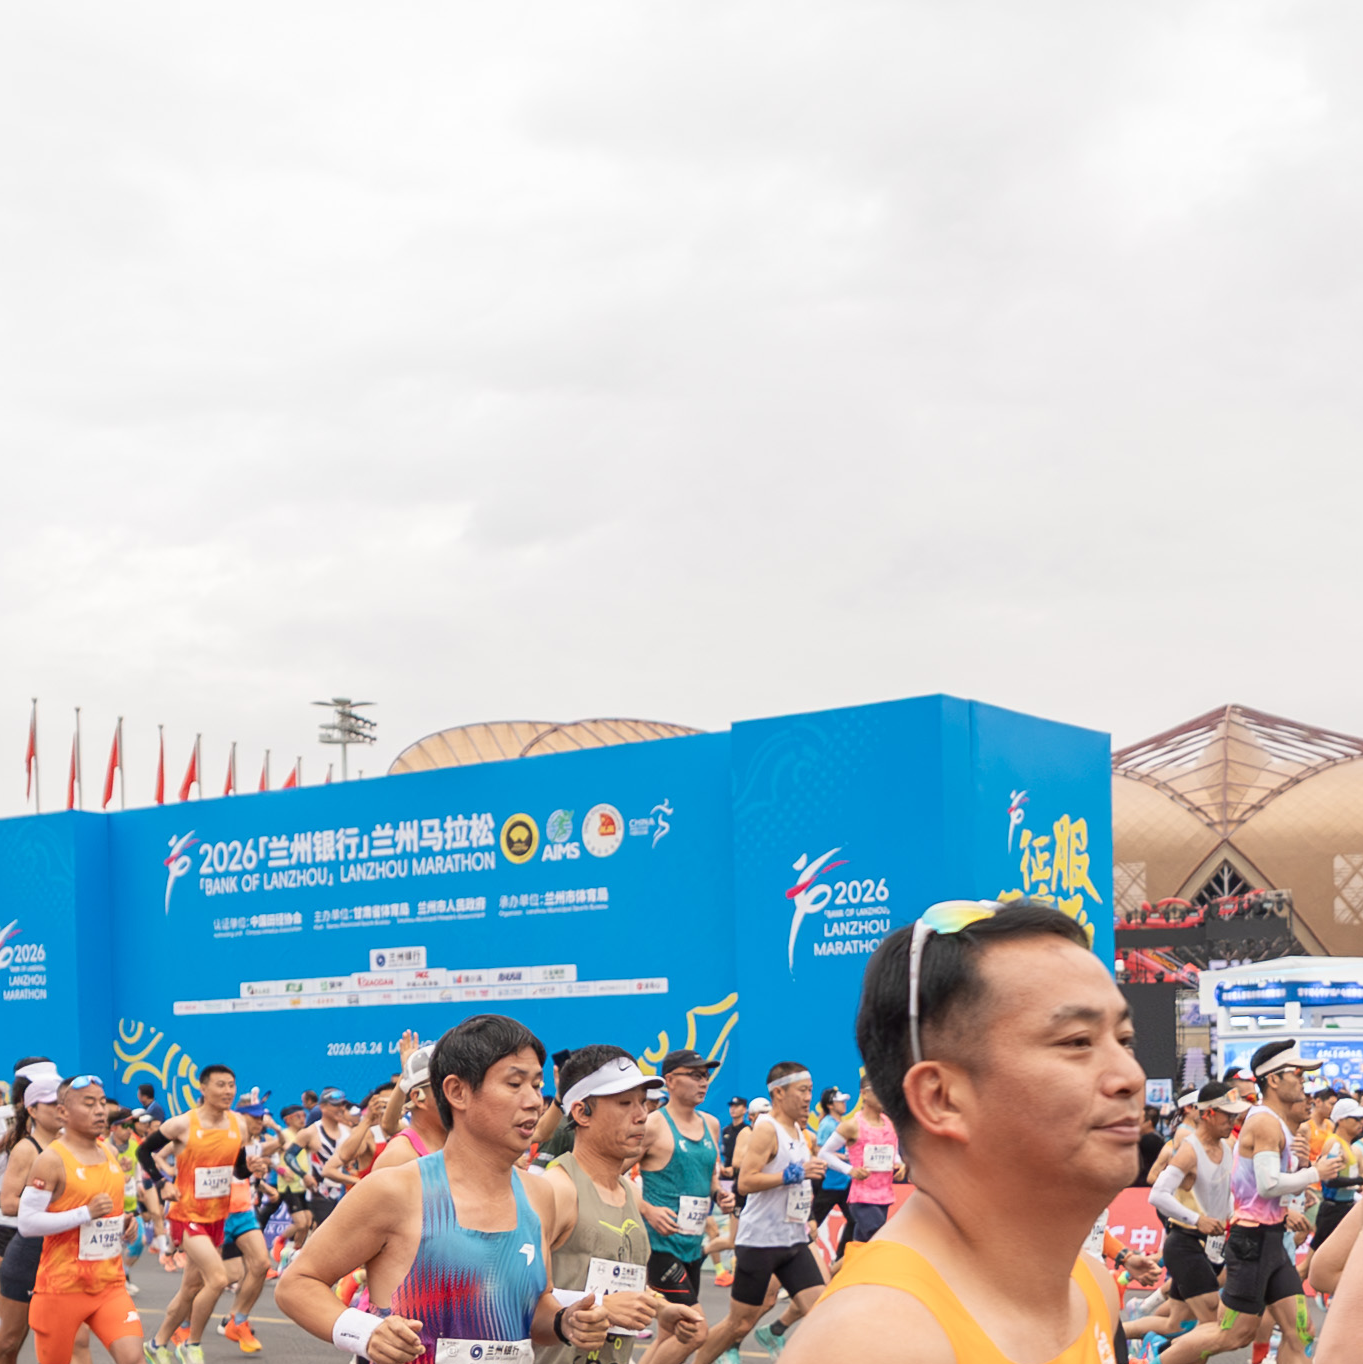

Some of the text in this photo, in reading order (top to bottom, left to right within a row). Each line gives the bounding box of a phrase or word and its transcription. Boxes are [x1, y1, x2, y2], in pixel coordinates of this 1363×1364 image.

[541, 842, 580, 862] AIMS
[241, 873, 260, 892] OF
[340, 860, 409, 883] LANZHOU
[412, 851, 496, 876] MARATHON
[833, 878, 890, 905] 2026
[823, 918, 891, 938] LANZHOU
[14, 943, 46, 963] 2026
[813, 938, 884, 957] MARATHO
[8, 974, 46, 987] LANZHOU
[3, 988, 47, 1001] MARATHON
[327, 1042, 382, 1056] 2026.05.24
[486, 1344, 520, 1356] 兰州银行
